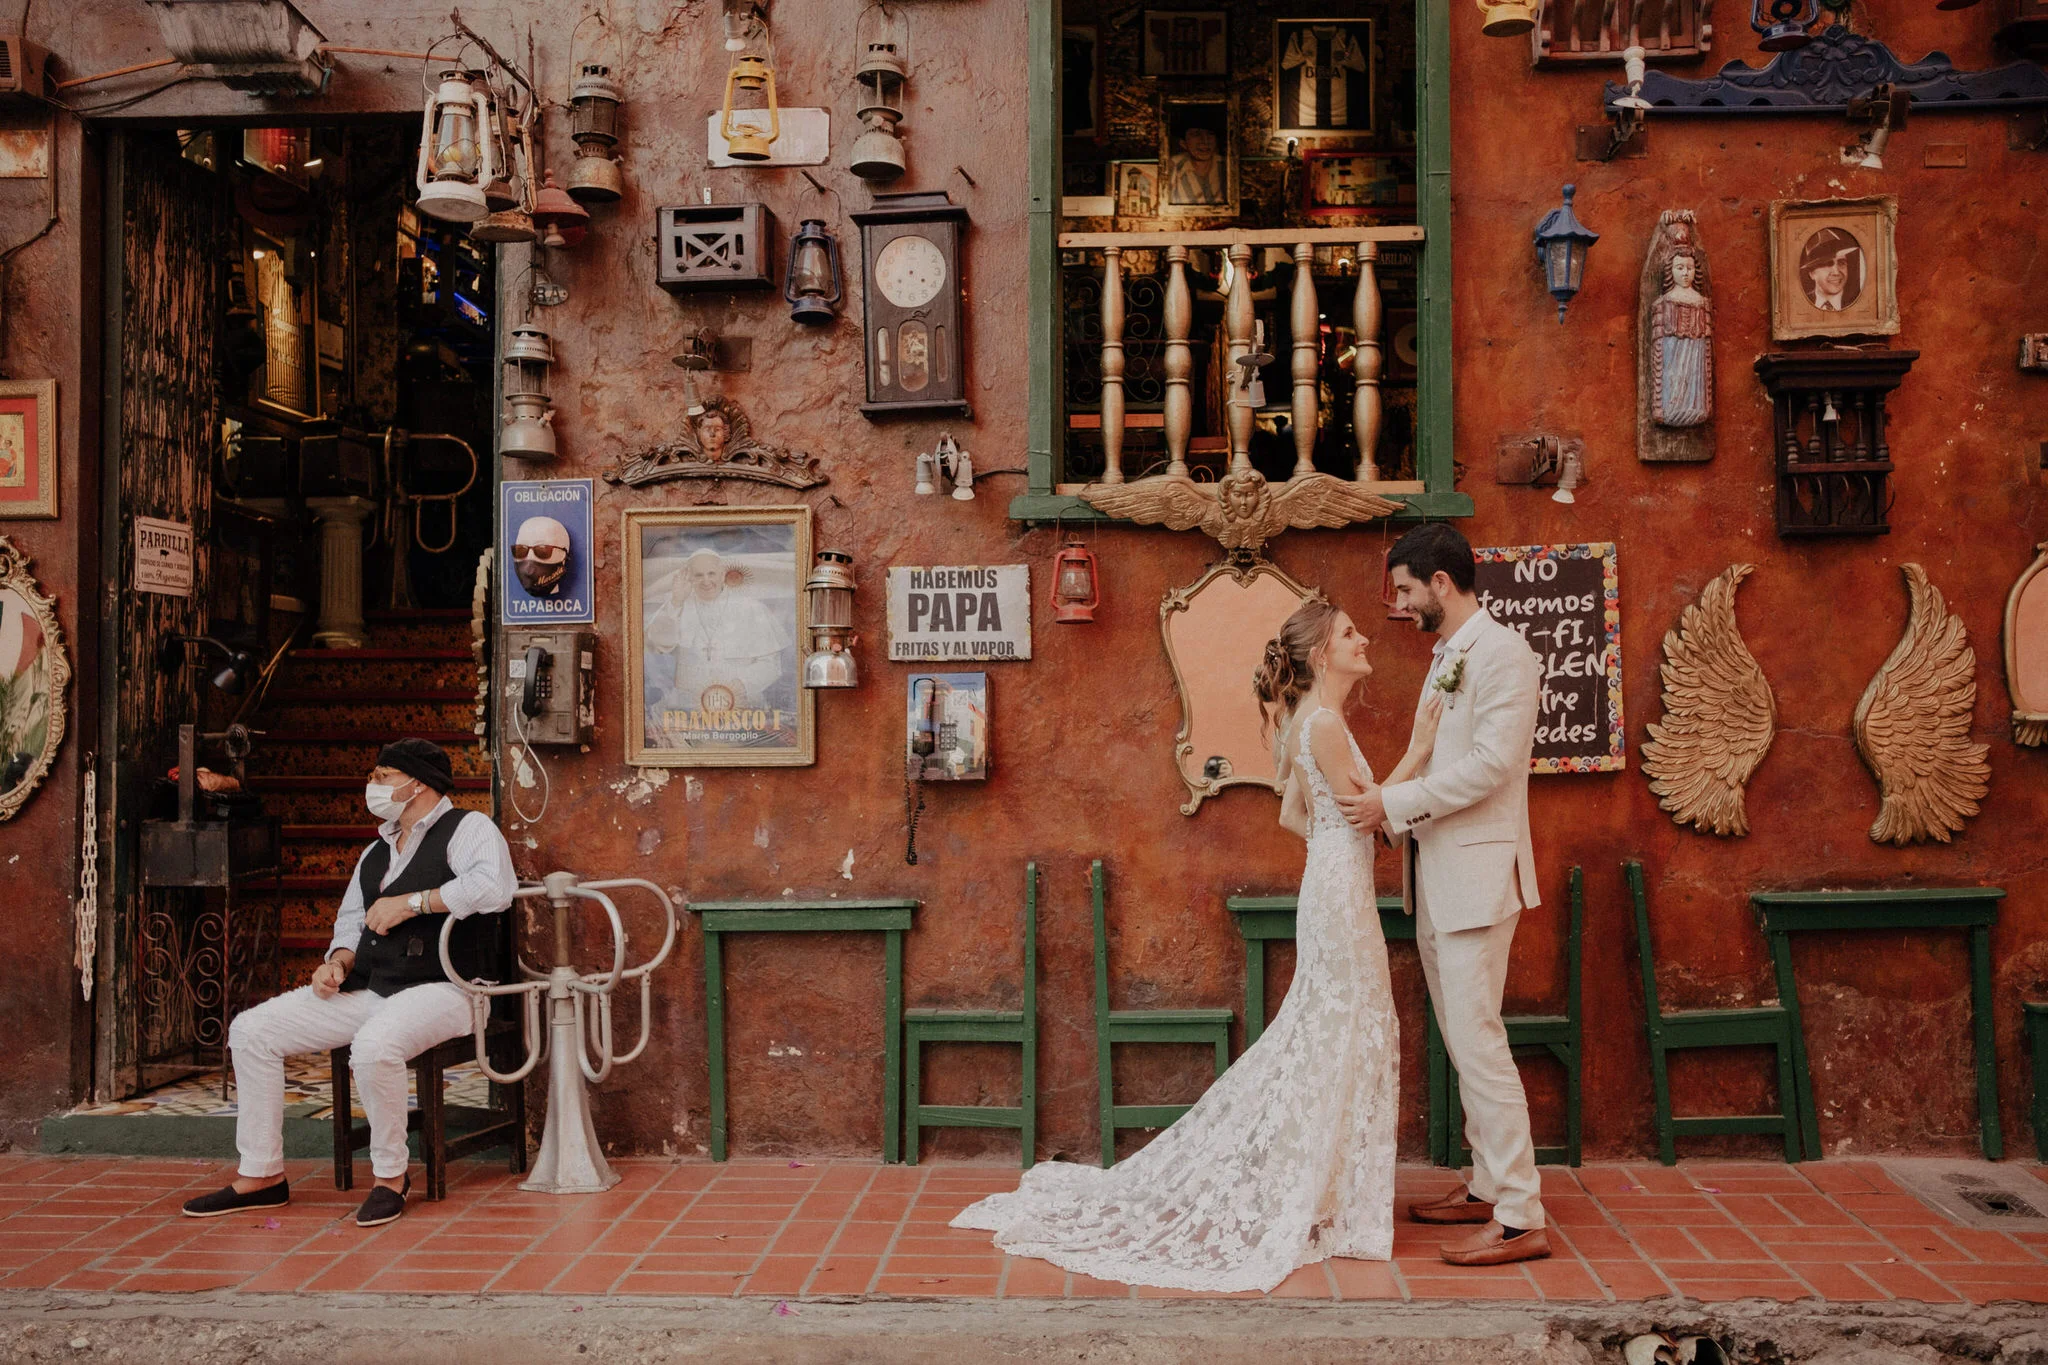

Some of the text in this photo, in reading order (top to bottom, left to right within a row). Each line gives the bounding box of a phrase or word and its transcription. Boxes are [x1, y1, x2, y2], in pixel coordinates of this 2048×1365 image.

[515, 488, 581, 503] OBLIGACIÓN
[140, 530, 190, 557] PARRILLA
[910, 569, 998, 589] HABEMUS
[1514, 558, 1558, 583] NO
[512, 599, 583, 613] TAPABOCA
[908, 592, 1002, 632] PAPA
[1477, 590, 1595, 617] tenemos
[895, 640, 1015, 657] FRITAS Y AL VAPOR
[663, 710, 783, 731] FRANCISCO I
[683, 731, 759, 742] Mario Bergoglio
